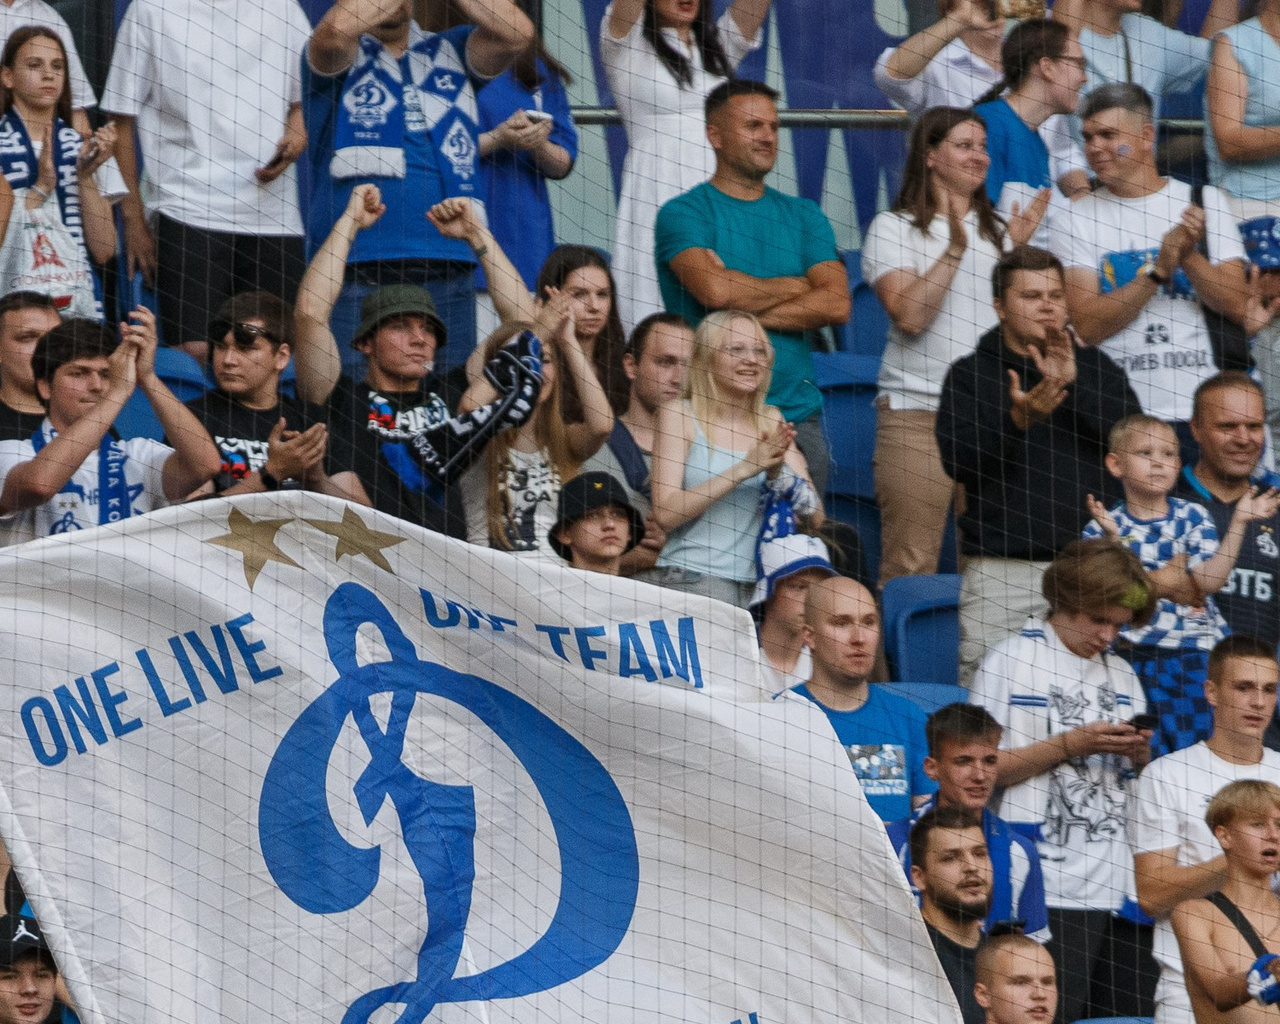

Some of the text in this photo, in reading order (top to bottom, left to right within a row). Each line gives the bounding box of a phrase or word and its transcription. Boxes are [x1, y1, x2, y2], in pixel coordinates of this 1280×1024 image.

[19, 662, 143, 766] ONE
[136, 611, 283, 717] LIVE
[535, 616, 704, 689] TEAM
